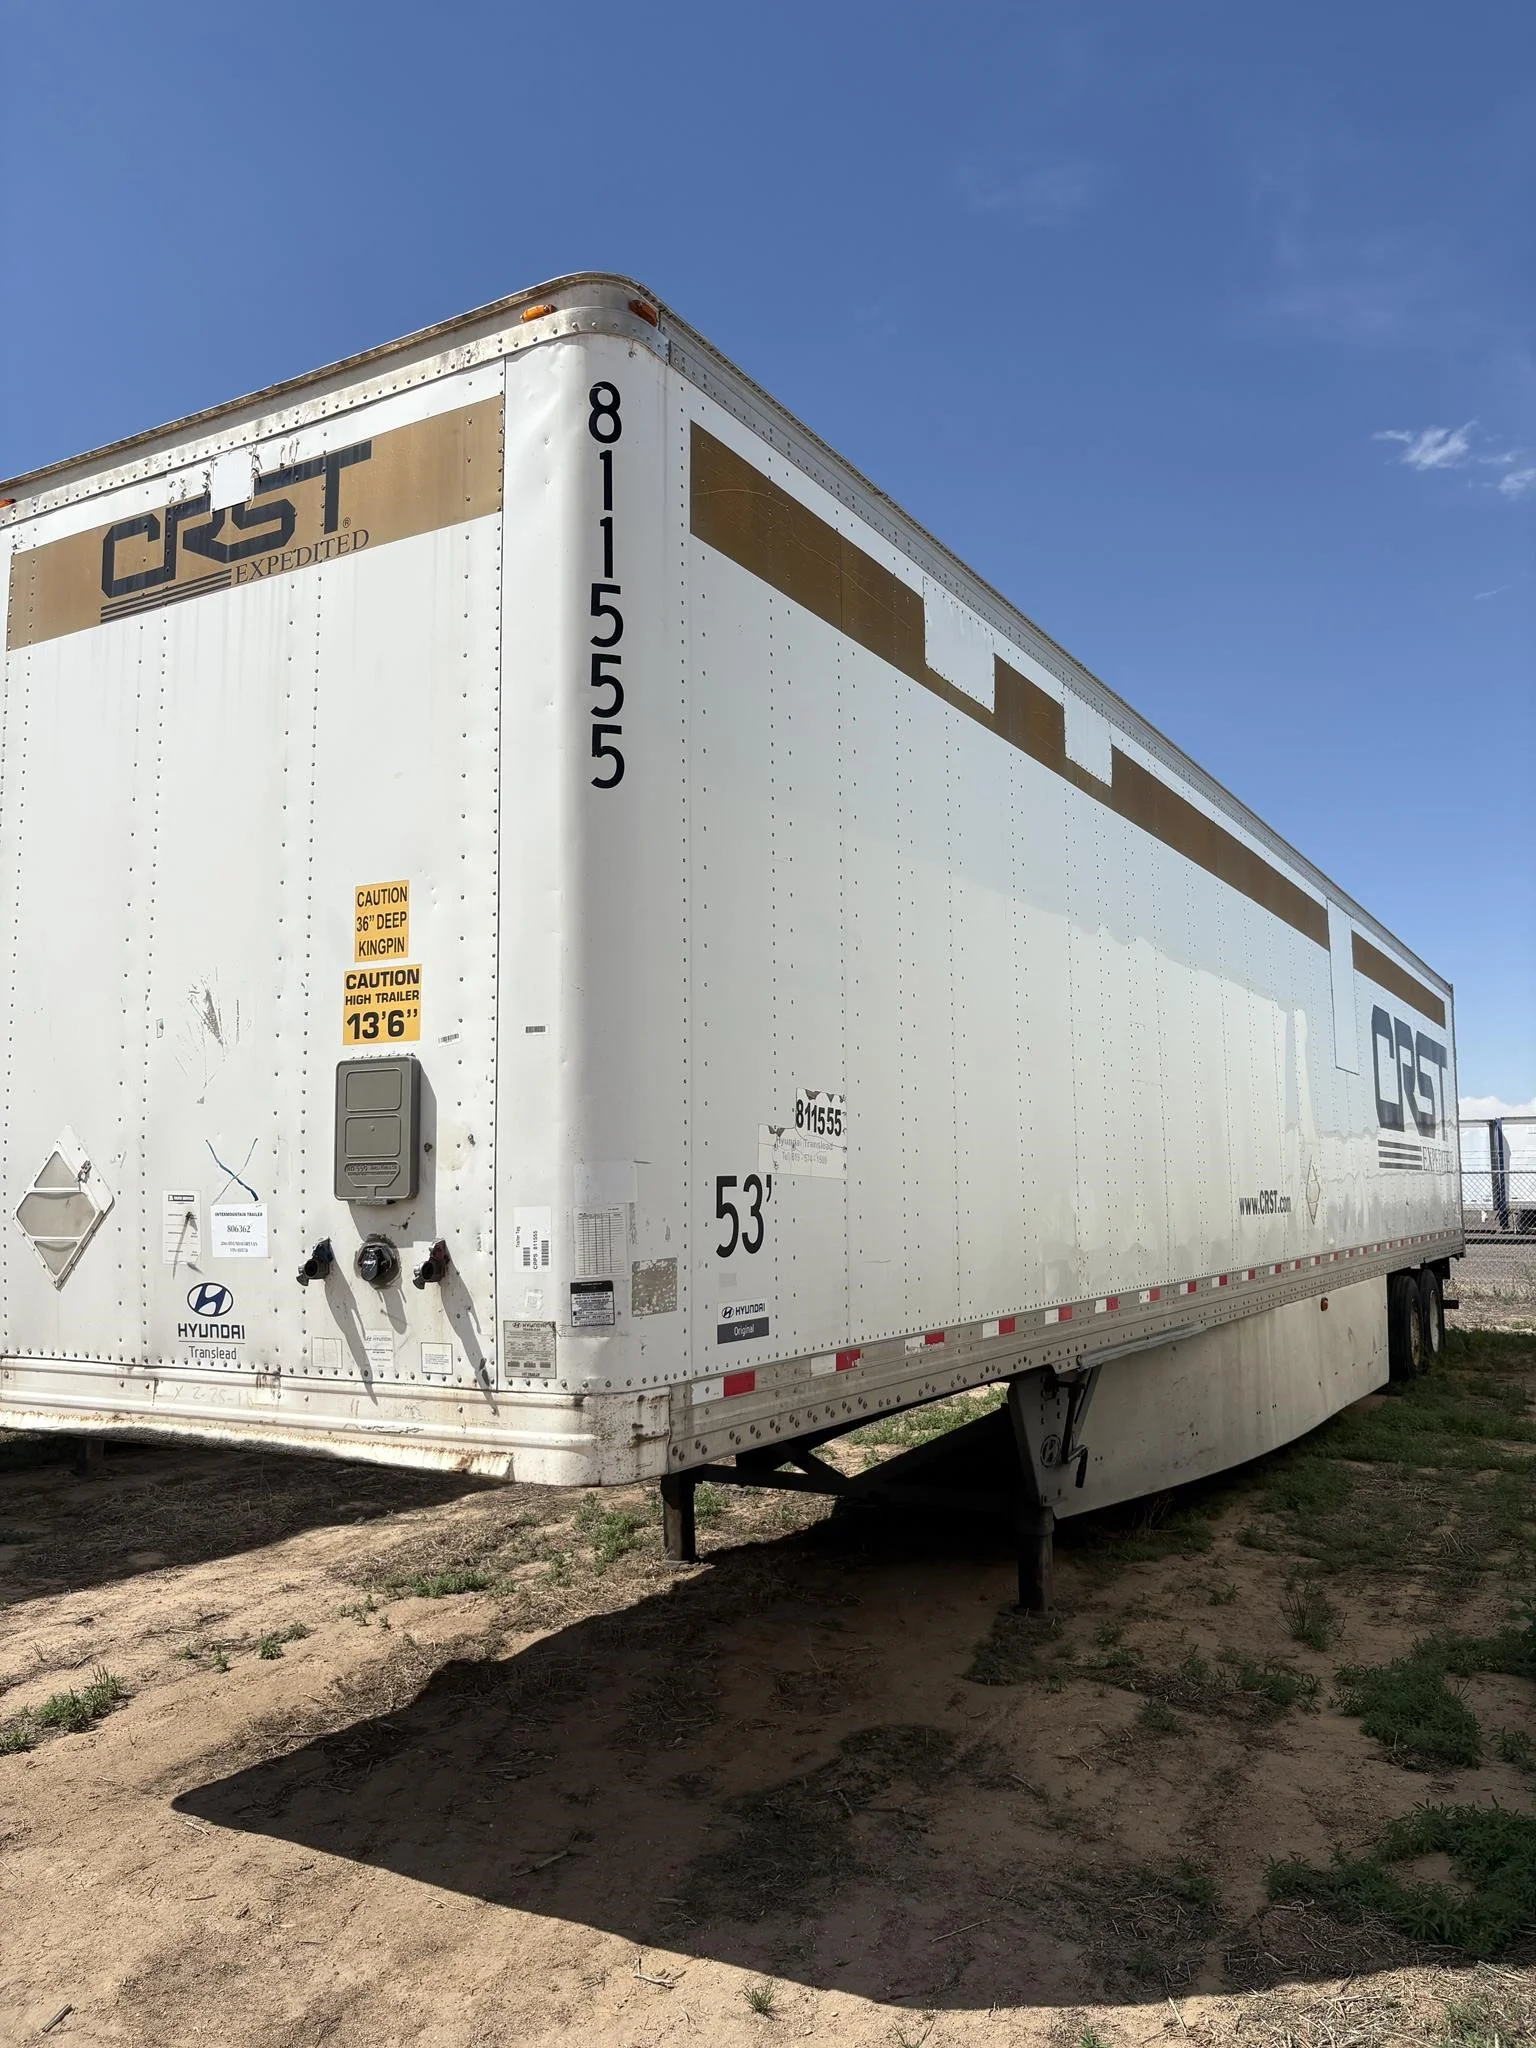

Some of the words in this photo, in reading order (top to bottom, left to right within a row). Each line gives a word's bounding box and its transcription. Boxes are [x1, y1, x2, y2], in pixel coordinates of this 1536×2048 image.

[101, 440, 372, 598] CRST
[235, 529, 369, 584] EXPEDITED
[588, 381, 625, 789] 811555
[357, 886, 408, 908] CAUTION
[376, 911, 407, 930] DEEP
[358, 936, 405, 957] KINGPIN
[345, 967, 420, 990] CAUTION
[345, 994, 372, 1006] HIGH
[375, 989, 420, 1004] TRAILER
[1371, 1004, 1448, 1142] CRST
[795, 1098, 842, 1136] 811555
[1239, 1189, 1291, 1216] www.CRST.com
[735, 1303, 766, 1316] HYUNDAI
[178, 1323, 245, 1340] HYUNDAI
[733, 1323, 755, 1338] Original
[188, 1345, 237, 1361] Translead
